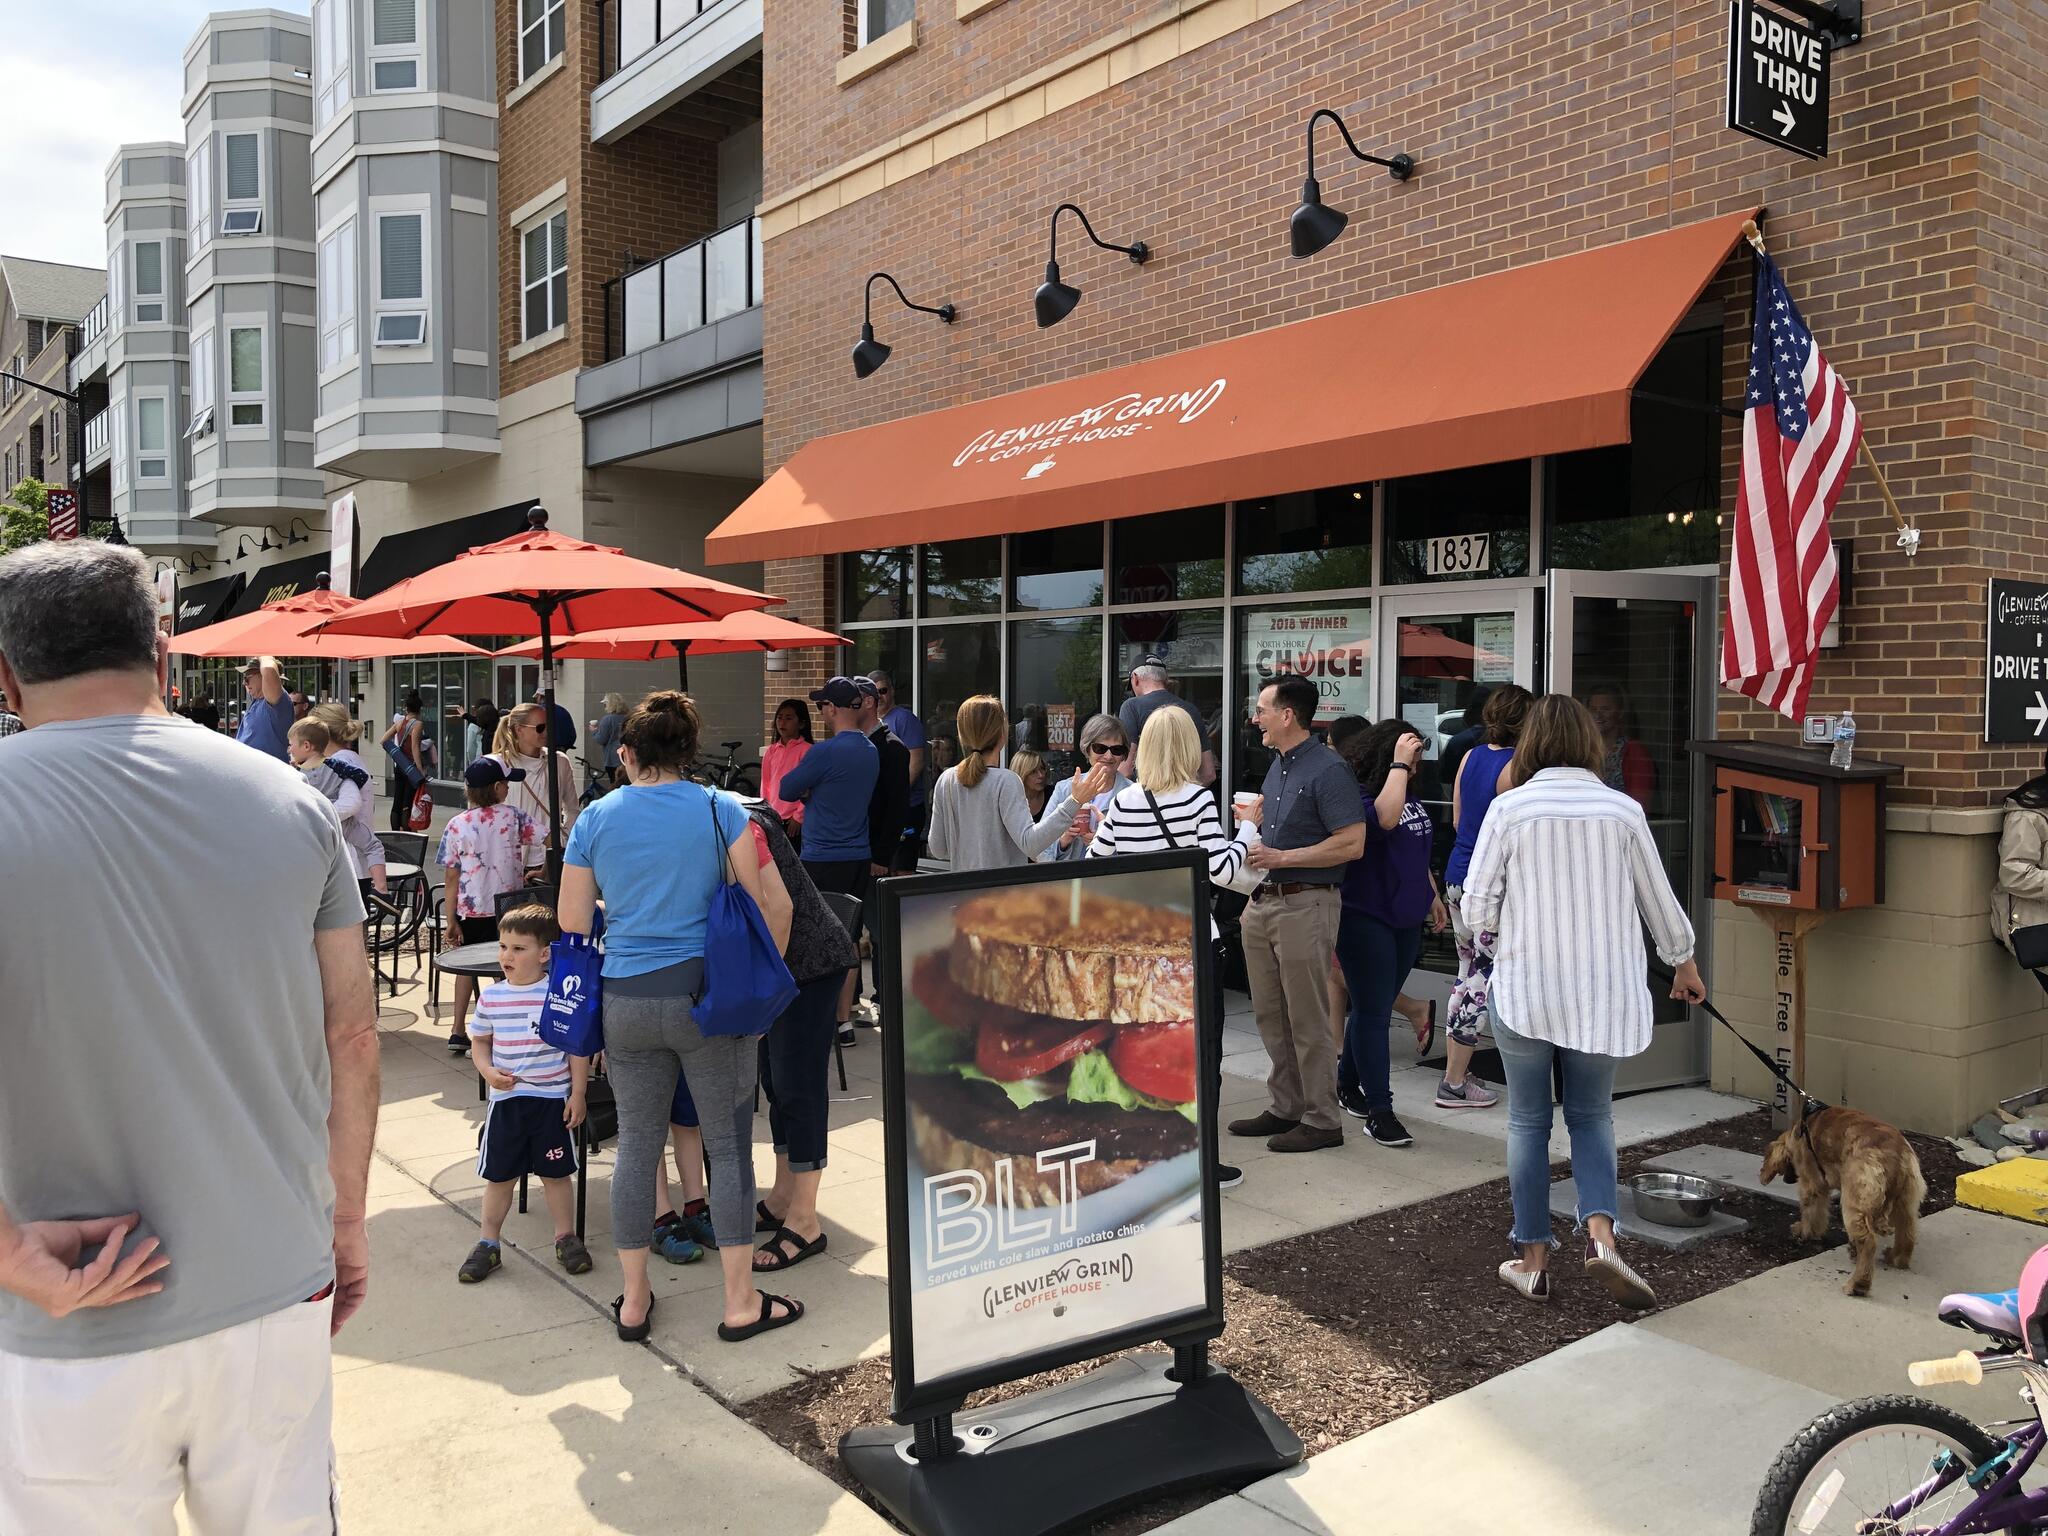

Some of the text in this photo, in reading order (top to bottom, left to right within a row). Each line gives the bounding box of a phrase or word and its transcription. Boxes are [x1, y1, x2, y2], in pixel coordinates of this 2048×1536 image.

[1751, 11, 1822, 72] DRIVE
[1753, 51, 1817, 105] THRU
[953, 379, 1226, 466] GLENVIEW GRIND
[989, 422, 1143, 462] COFFEE HOUSE
[1432, 535, 1489, 572] 1837
[264, 582, 300, 605] YOGA
[1270, 616, 1348, 630] 2018 WINNER
[2014, 615, 2040, 625] COFFEE
[1256, 649, 1363, 678] CHOICE
[1994, 655, 2040, 680] DRIVE
[1048, 713, 1070, 727] BEST
[1048, 728, 1074, 744] 2018
[1773, 931, 1793, 1115] Little Free Library
[545, 1146, 564, 1160] 45
[923, 1139, 1096, 1270] BLT
[927, 1223, 1146, 1287] Served with cole slaw and potato chips
[983, 1252, 1133, 1319] GLENVIEW GRIND
[1014, 1281, 1102, 1313] COFFEE HOUSE
